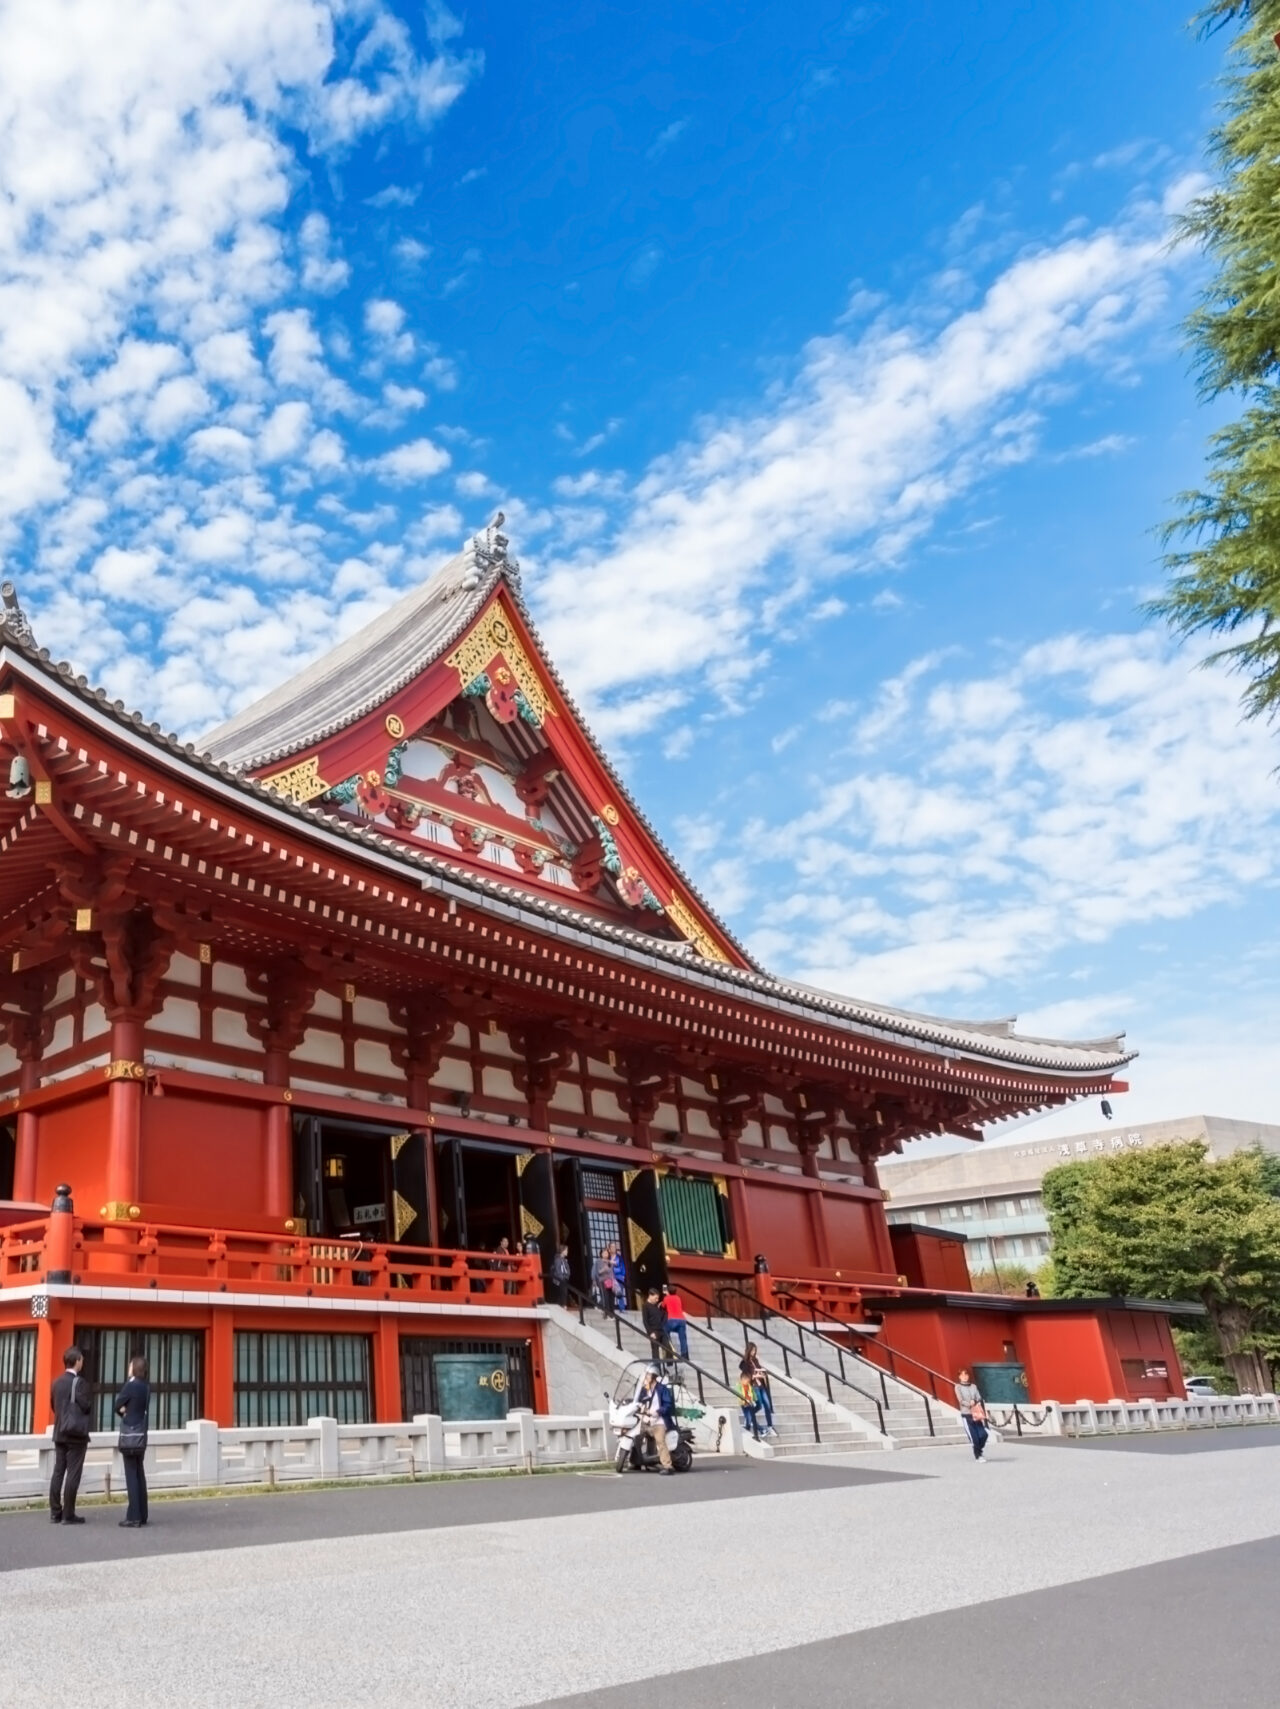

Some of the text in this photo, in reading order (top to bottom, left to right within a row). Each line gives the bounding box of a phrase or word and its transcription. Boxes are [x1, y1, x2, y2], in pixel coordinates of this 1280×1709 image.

[1059, 1132, 1142, 1157] 浅草寺病院
